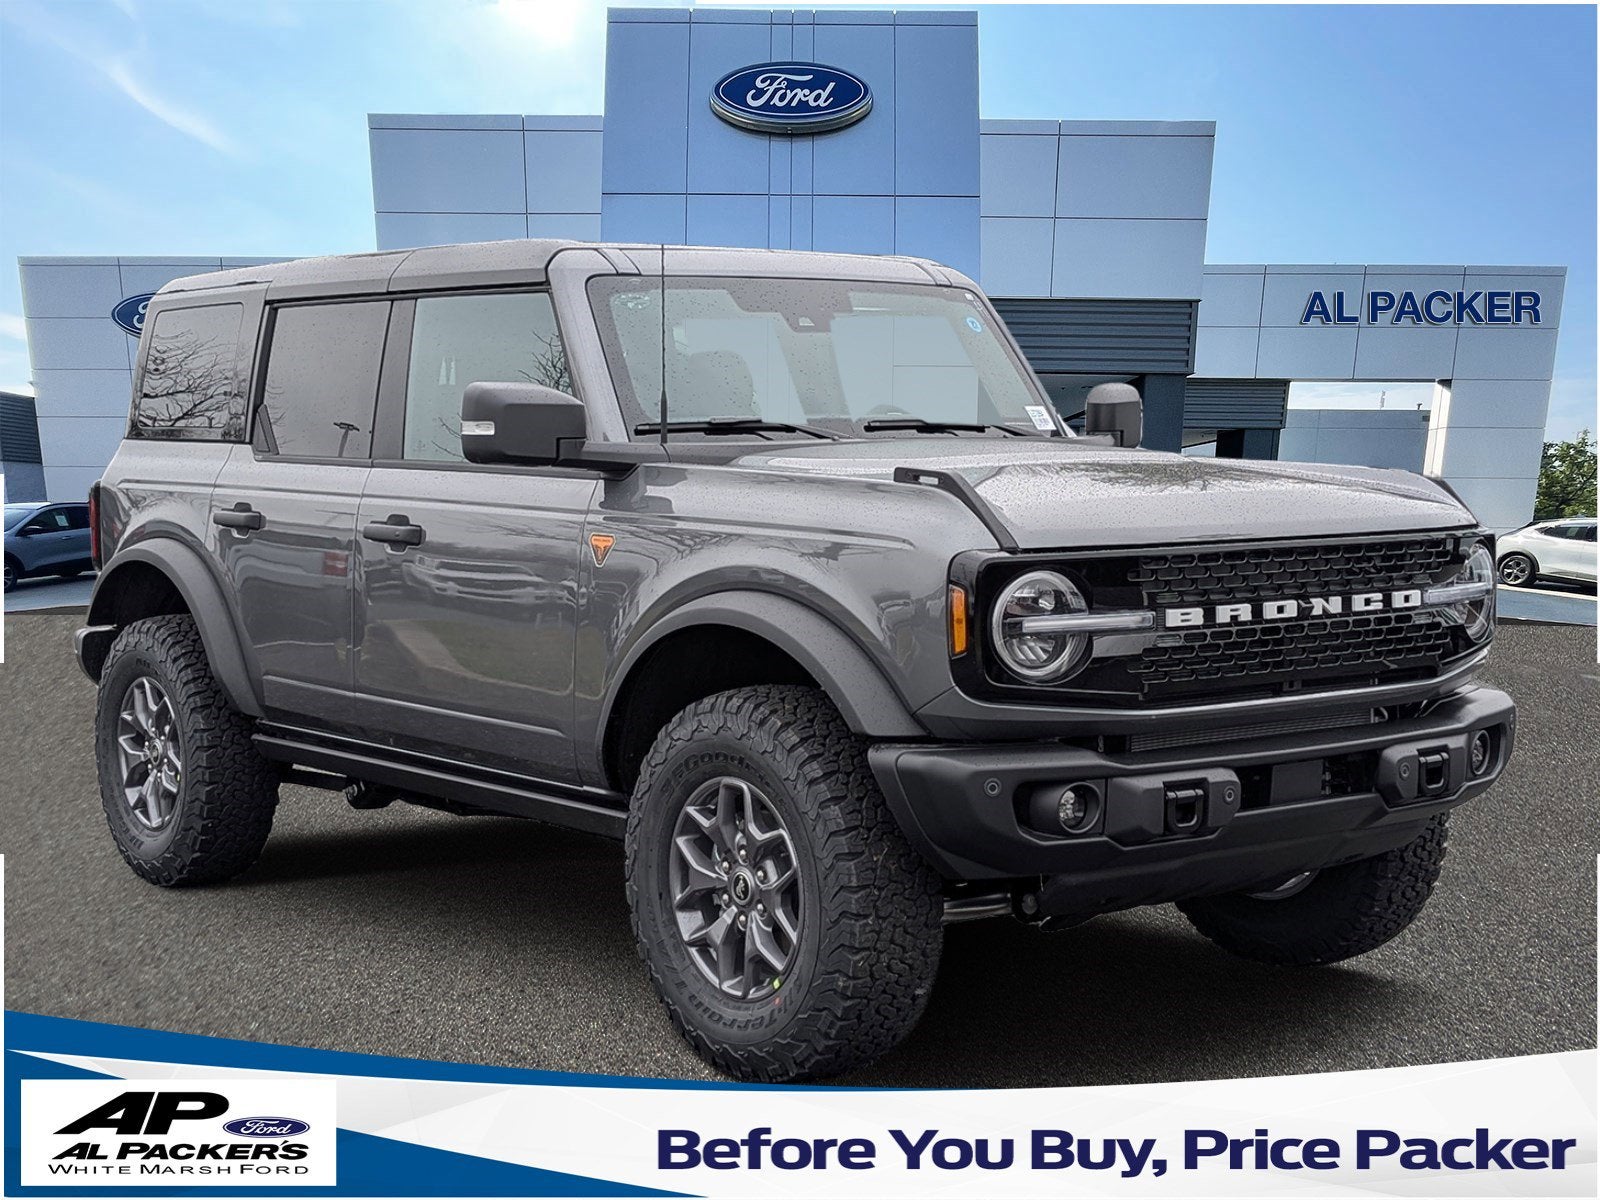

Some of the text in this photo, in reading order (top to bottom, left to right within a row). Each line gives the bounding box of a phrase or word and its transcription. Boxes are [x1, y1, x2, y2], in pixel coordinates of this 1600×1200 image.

[746, 72, 836, 108] Ford
[1301, 290, 1542, 324] AL PACKER
[1165, 589, 1422, 628] BRONCO
